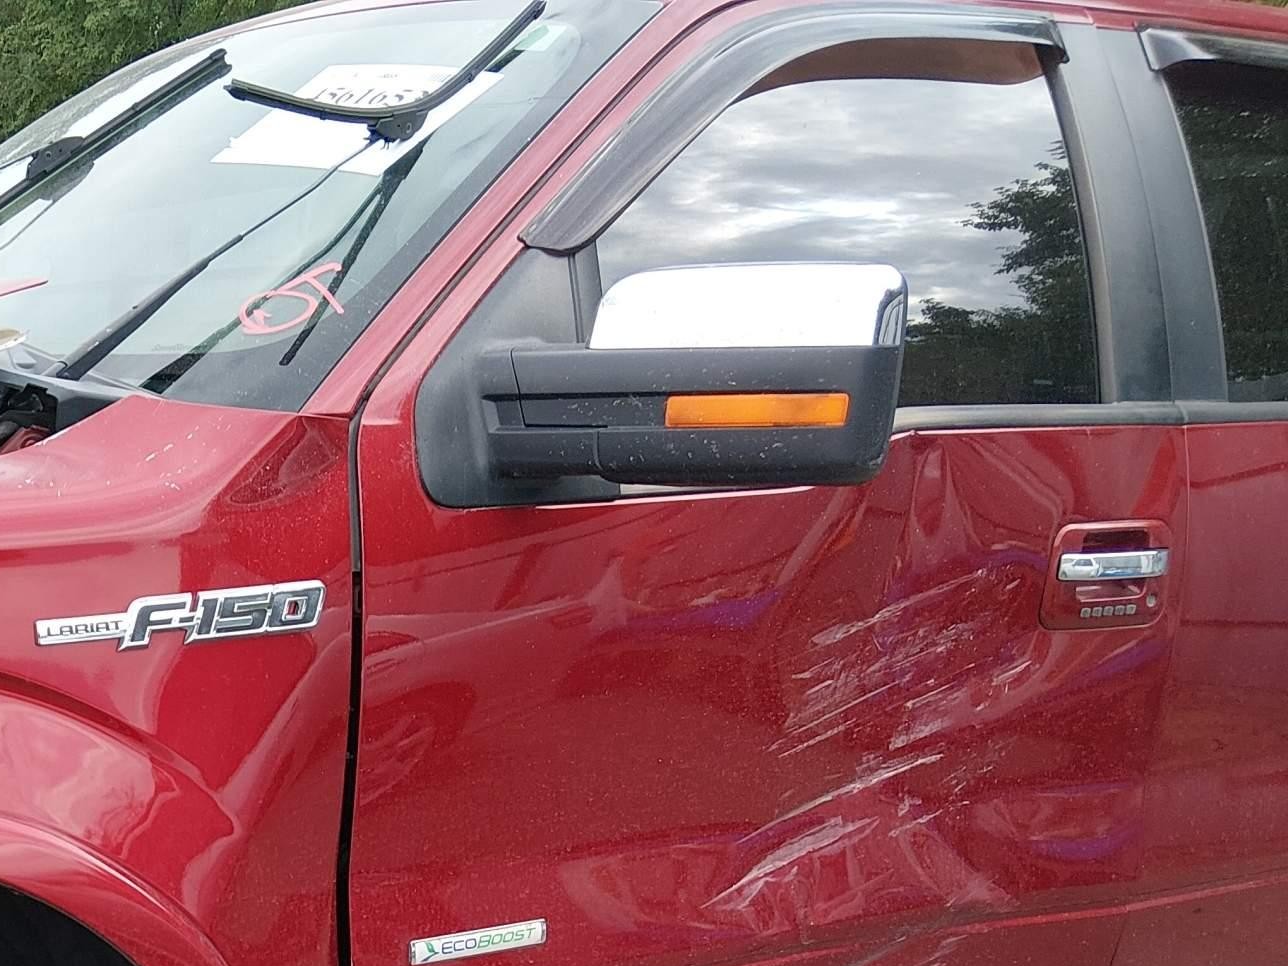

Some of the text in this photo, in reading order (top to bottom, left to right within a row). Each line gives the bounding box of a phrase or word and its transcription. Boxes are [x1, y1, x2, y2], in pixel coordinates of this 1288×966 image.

[46, 581, 326, 649] LARIAT F-150
[441, 927, 537, 955] ECOBOOST
